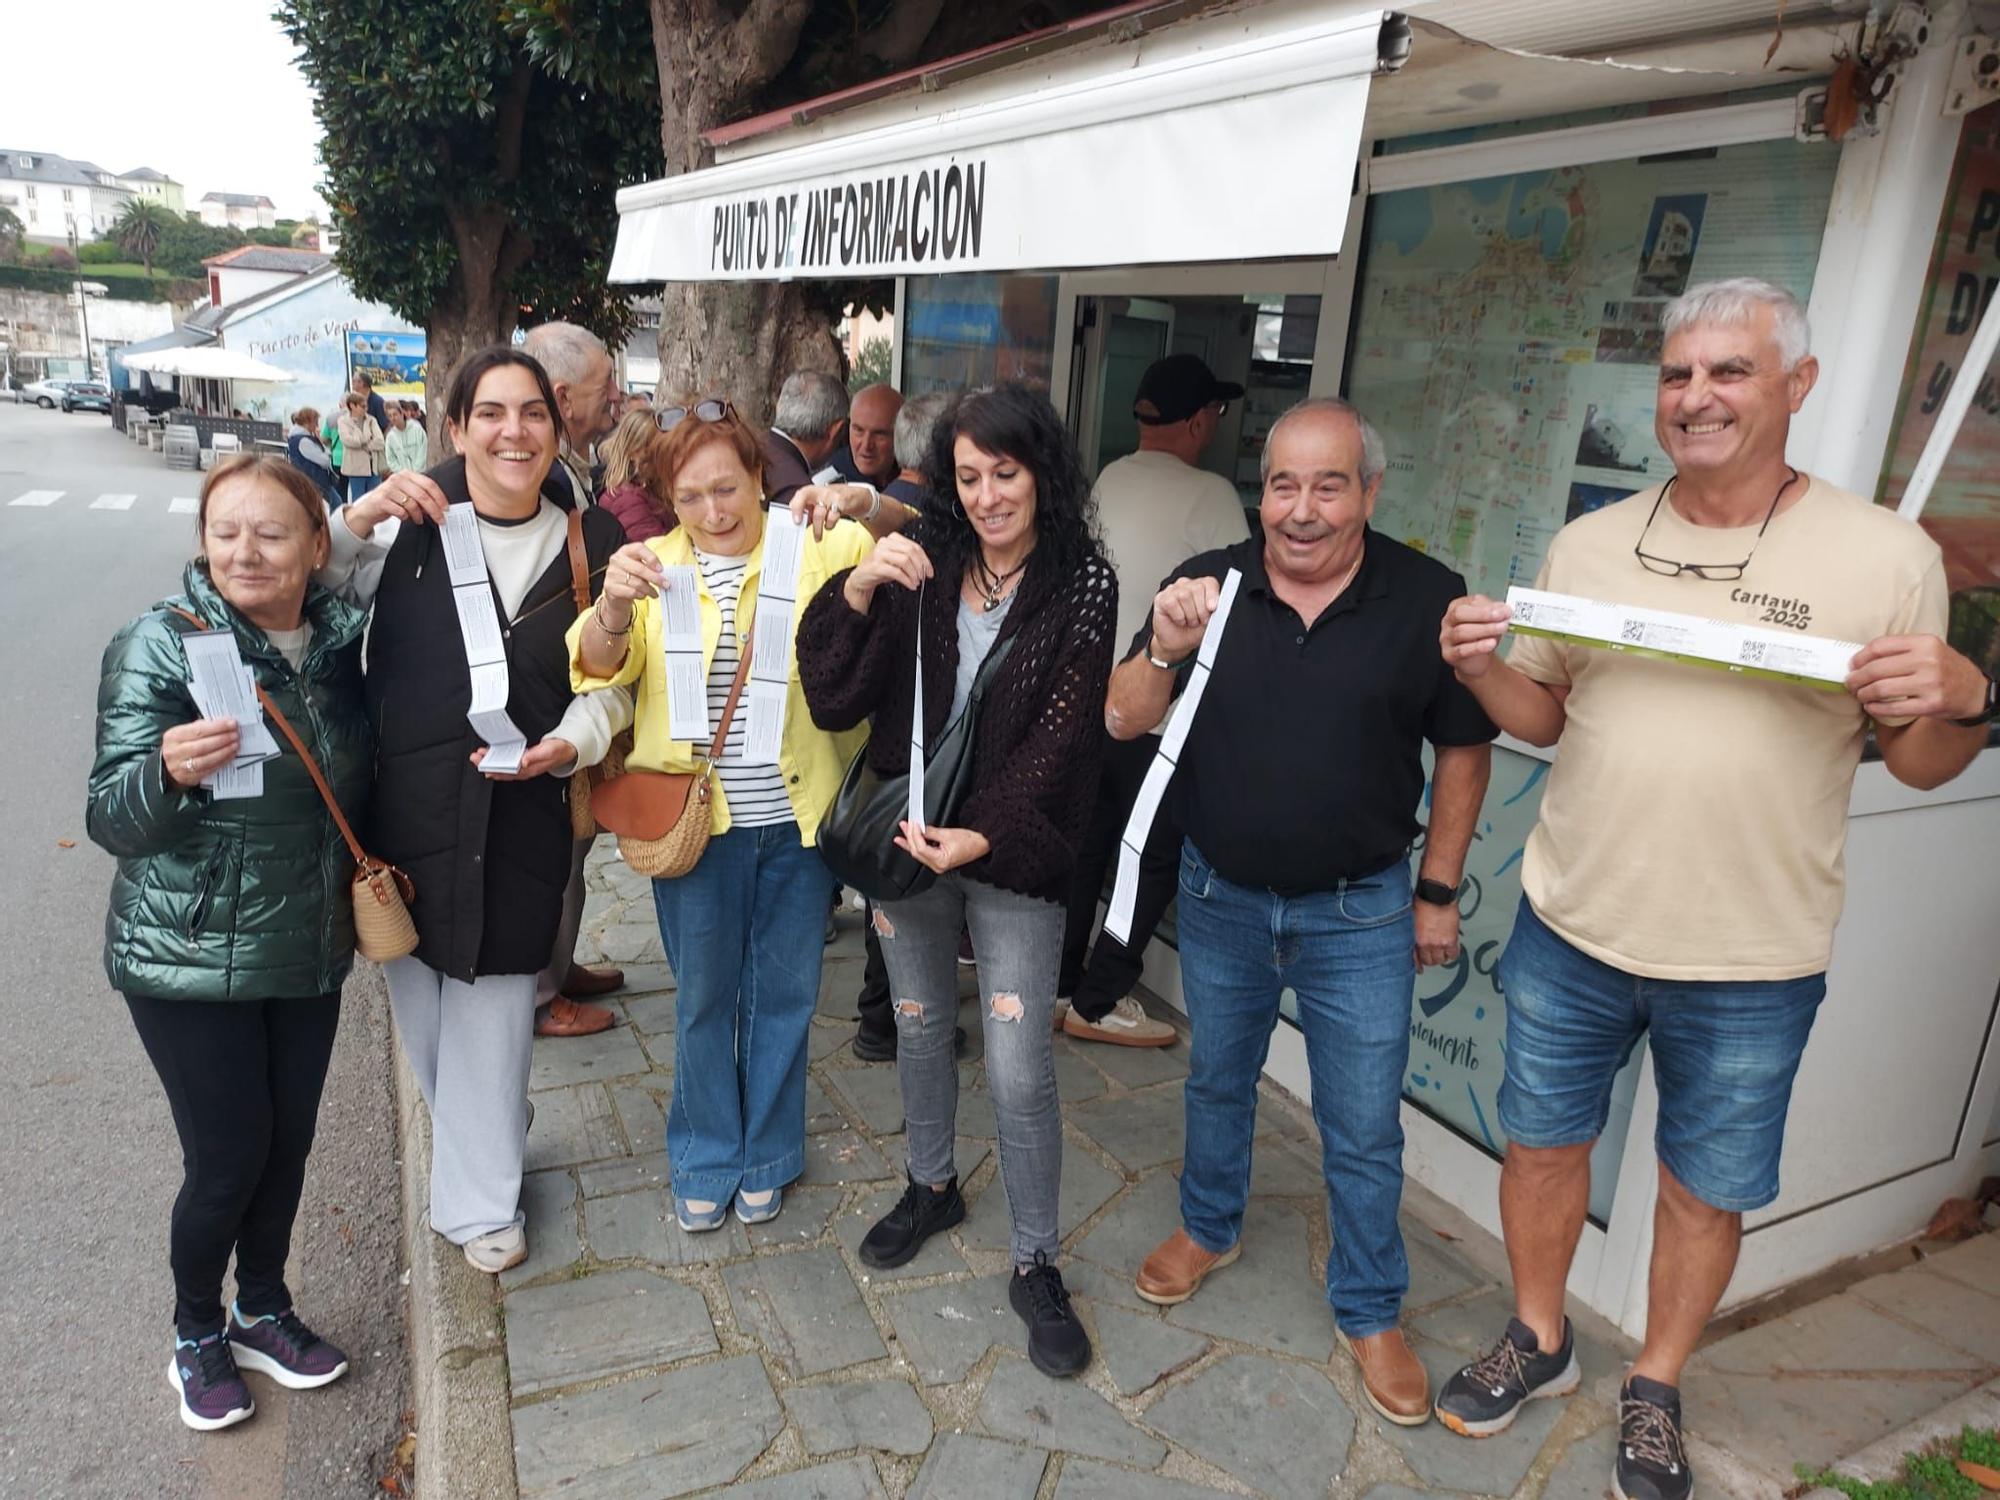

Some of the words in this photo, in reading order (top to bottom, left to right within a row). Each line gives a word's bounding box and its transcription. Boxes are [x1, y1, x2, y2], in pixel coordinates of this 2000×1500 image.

[712, 198, 769, 271] PUNTO
[774, 194, 798, 269] DE
[801, 156, 986, 266] INFORMACIÓN
[304, 326, 320, 348] de
[1730, 588, 1810, 614] Cartavio
[1759, 608, 1812, 630] 2025
